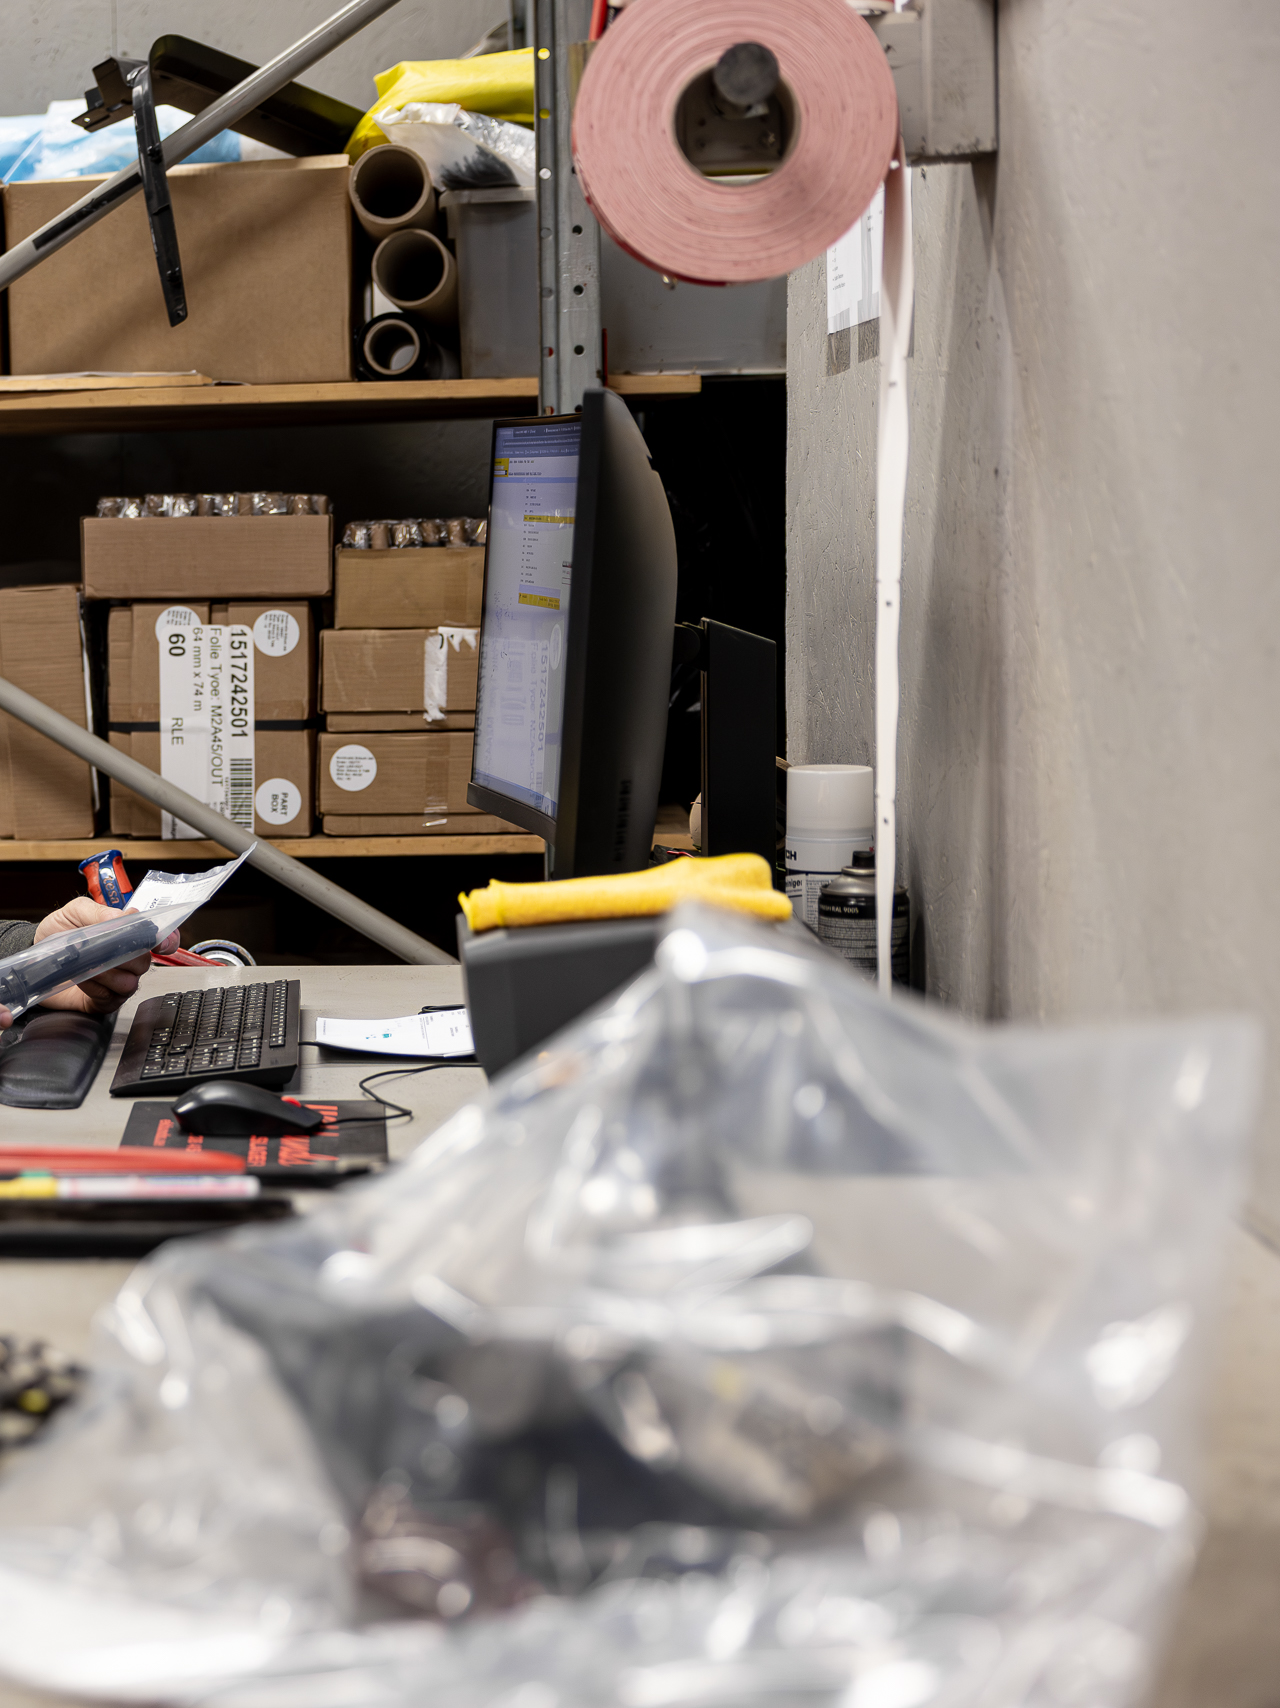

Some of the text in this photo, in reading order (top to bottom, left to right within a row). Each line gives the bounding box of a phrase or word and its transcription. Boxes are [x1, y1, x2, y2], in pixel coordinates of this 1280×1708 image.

[168, 633, 186, 657] 60
[192, 627, 203, 642] 64
[210, 628, 222, 659] Folie
[193, 646, 201, 668] mm
[193, 682, 204, 696] 74
[230, 629, 249, 737] 1517242501
[194, 700, 202, 711] m
[171, 717, 184, 745] RLE
[210, 705, 223, 787] M2A45/OUT
[271, 793, 279, 813] BOX
[280, 792, 289, 816] PART
[103, 875, 120, 905] tesa
